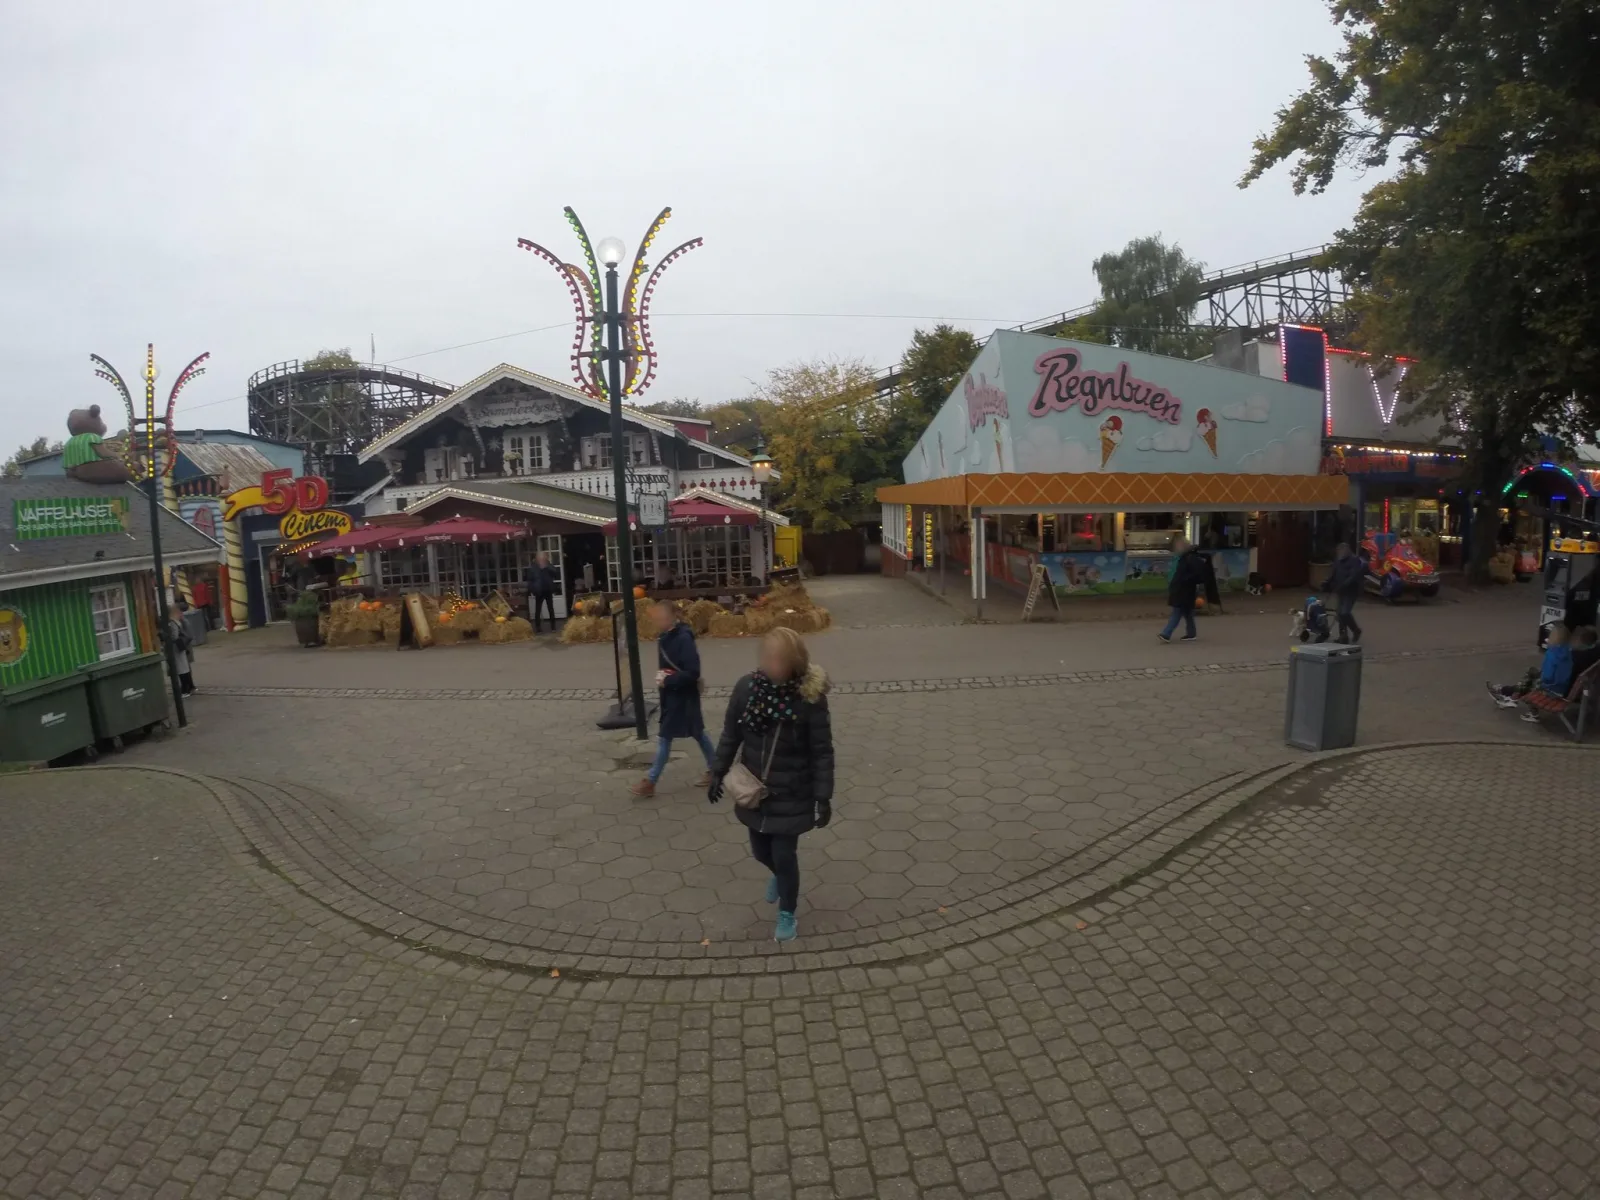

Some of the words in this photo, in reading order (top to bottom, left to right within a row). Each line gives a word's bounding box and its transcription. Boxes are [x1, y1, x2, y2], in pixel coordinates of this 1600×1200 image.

[1034, 353, 1181, 422] Regnbuen
[261, 468, 328, 514] 5D
[19, 504, 114, 521] VAFFELHUSET
[284, 513, 347, 538] Cinema
[1545, 607, 1562, 618] ATM
